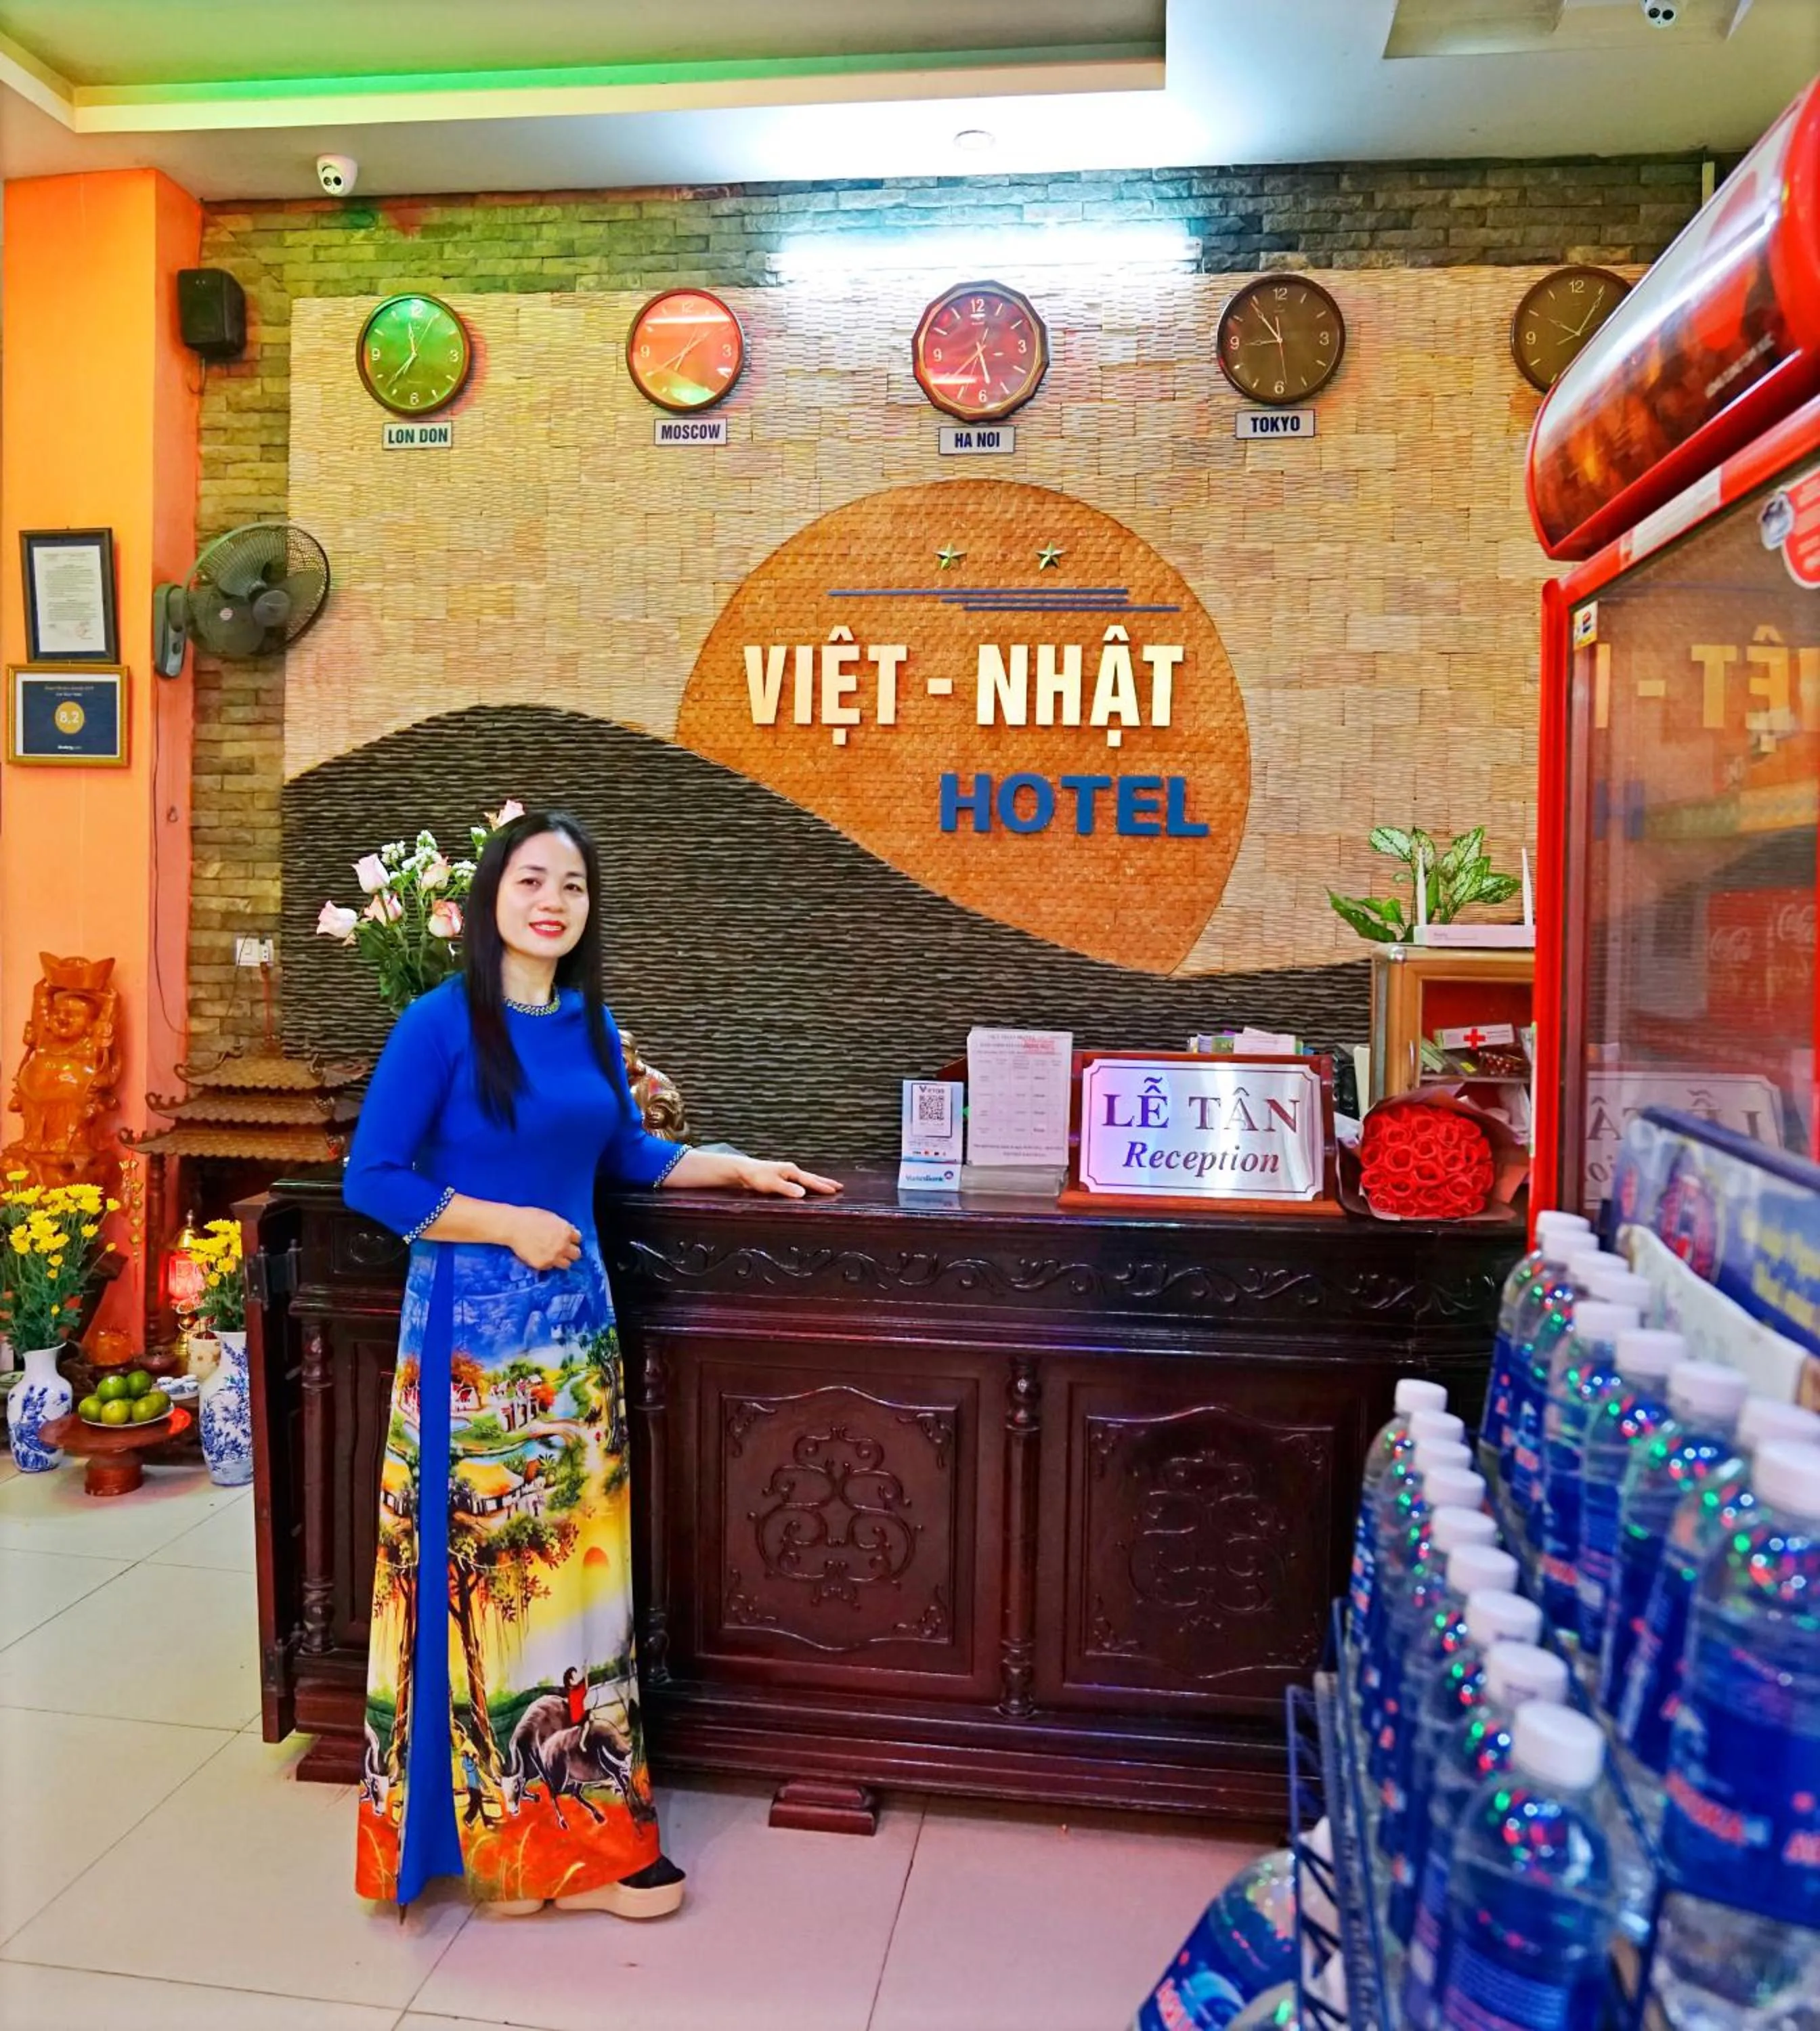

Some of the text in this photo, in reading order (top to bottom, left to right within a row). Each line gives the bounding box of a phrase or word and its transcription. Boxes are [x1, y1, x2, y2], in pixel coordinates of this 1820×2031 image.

[1569, 280, 1584, 293] 12
[1273, 288, 1288, 300] 12
[681, 301, 694, 313] 12
[971, 299, 984, 313] 12
[1230, 336, 1240, 350] 9
[1319, 331, 1329, 346] 3
[1525, 331, 1536, 345] 9
[641, 346, 651, 358] 9
[722, 344, 732, 357] 3
[1018, 339, 1026, 353] 3
[372, 347, 381, 361] 9
[450, 349, 459, 362] 3
[933, 348, 942, 362] 9
[1274, 380, 1284, 395] 6
[410, 392, 419, 405] 6
[978, 389, 987, 403] 6
[661, 424, 721, 439] MOSCOW
[1251, 416, 1301, 433] TOKYO
[955, 431, 1000, 447] HA NOI
[744, 625, 908, 746] VIỆT
[976, 624, 1184, 747] NHẬT
[939, 772, 1211, 837] HOTEL
[1102, 1076, 1170, 1129] LỄ
[1188, 1087, 1301, 1133] TÂN
[1122, 1141, 1280, 1178] Reception
